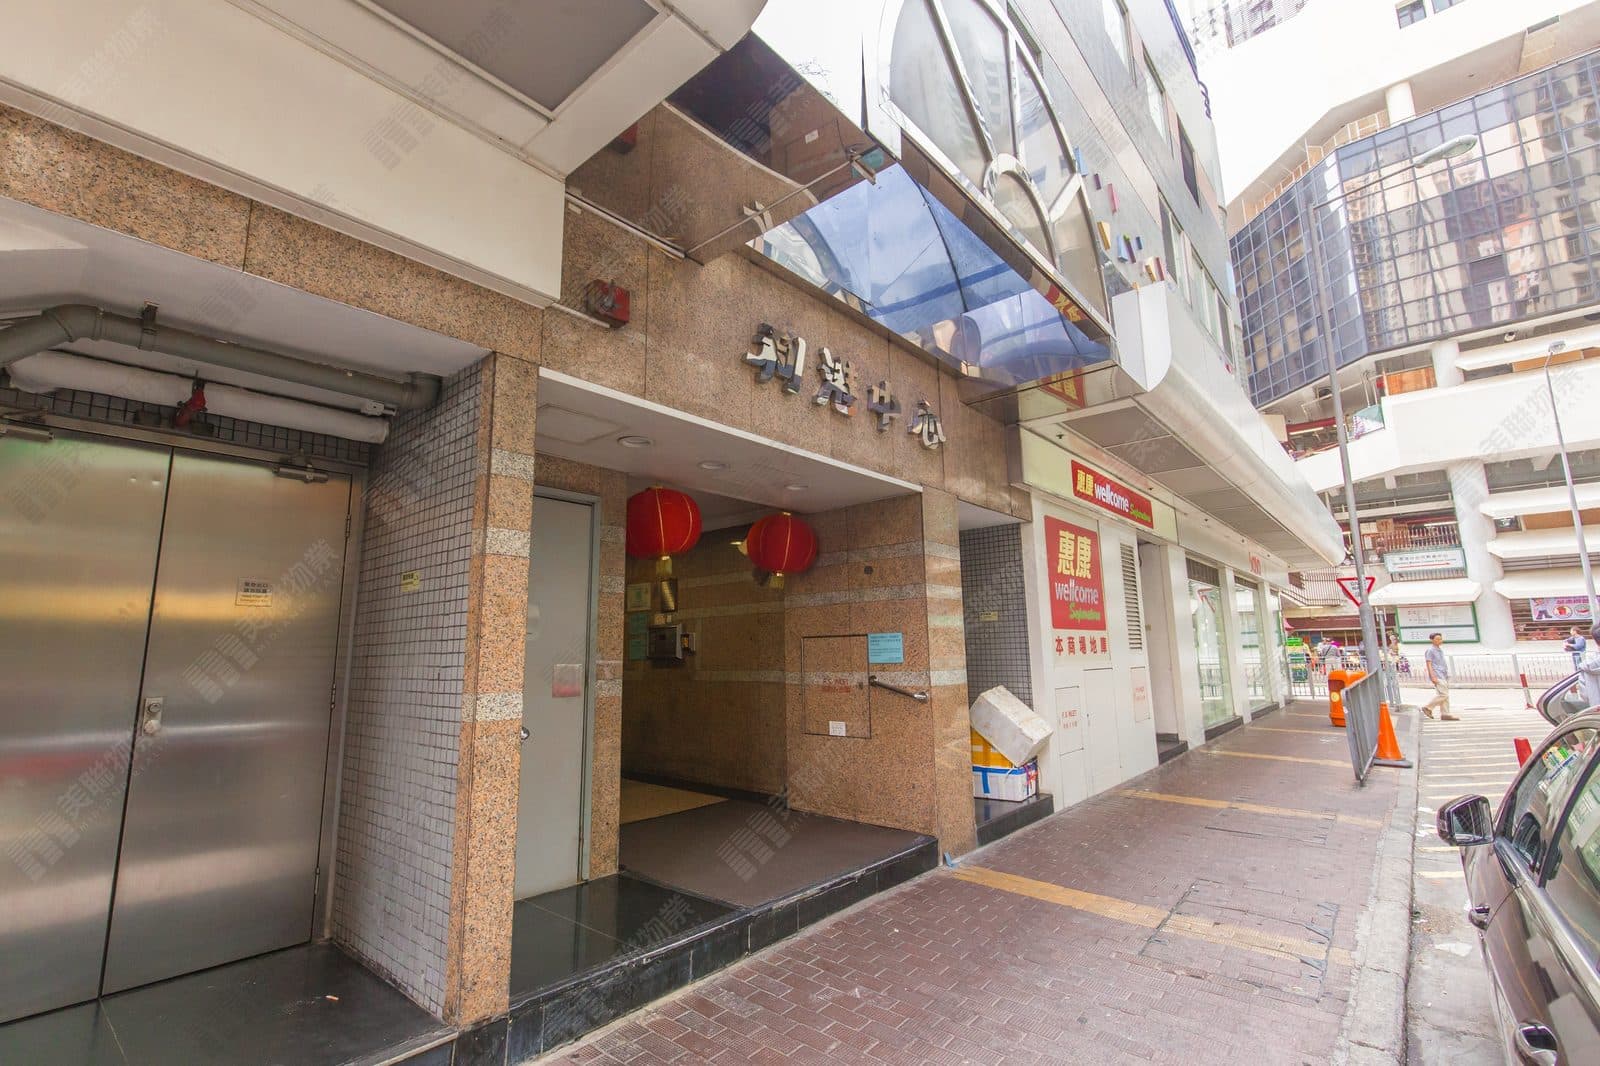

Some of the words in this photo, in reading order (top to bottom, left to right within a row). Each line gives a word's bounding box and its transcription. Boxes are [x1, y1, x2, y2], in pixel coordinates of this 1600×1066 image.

[1076, 469, 1094, 497] 惠康
[1094, 483, 1130, 513] wellcome
[1057, 530, 1092, 579] 惠康
[1055, 579, 1099, 604] wellcome
